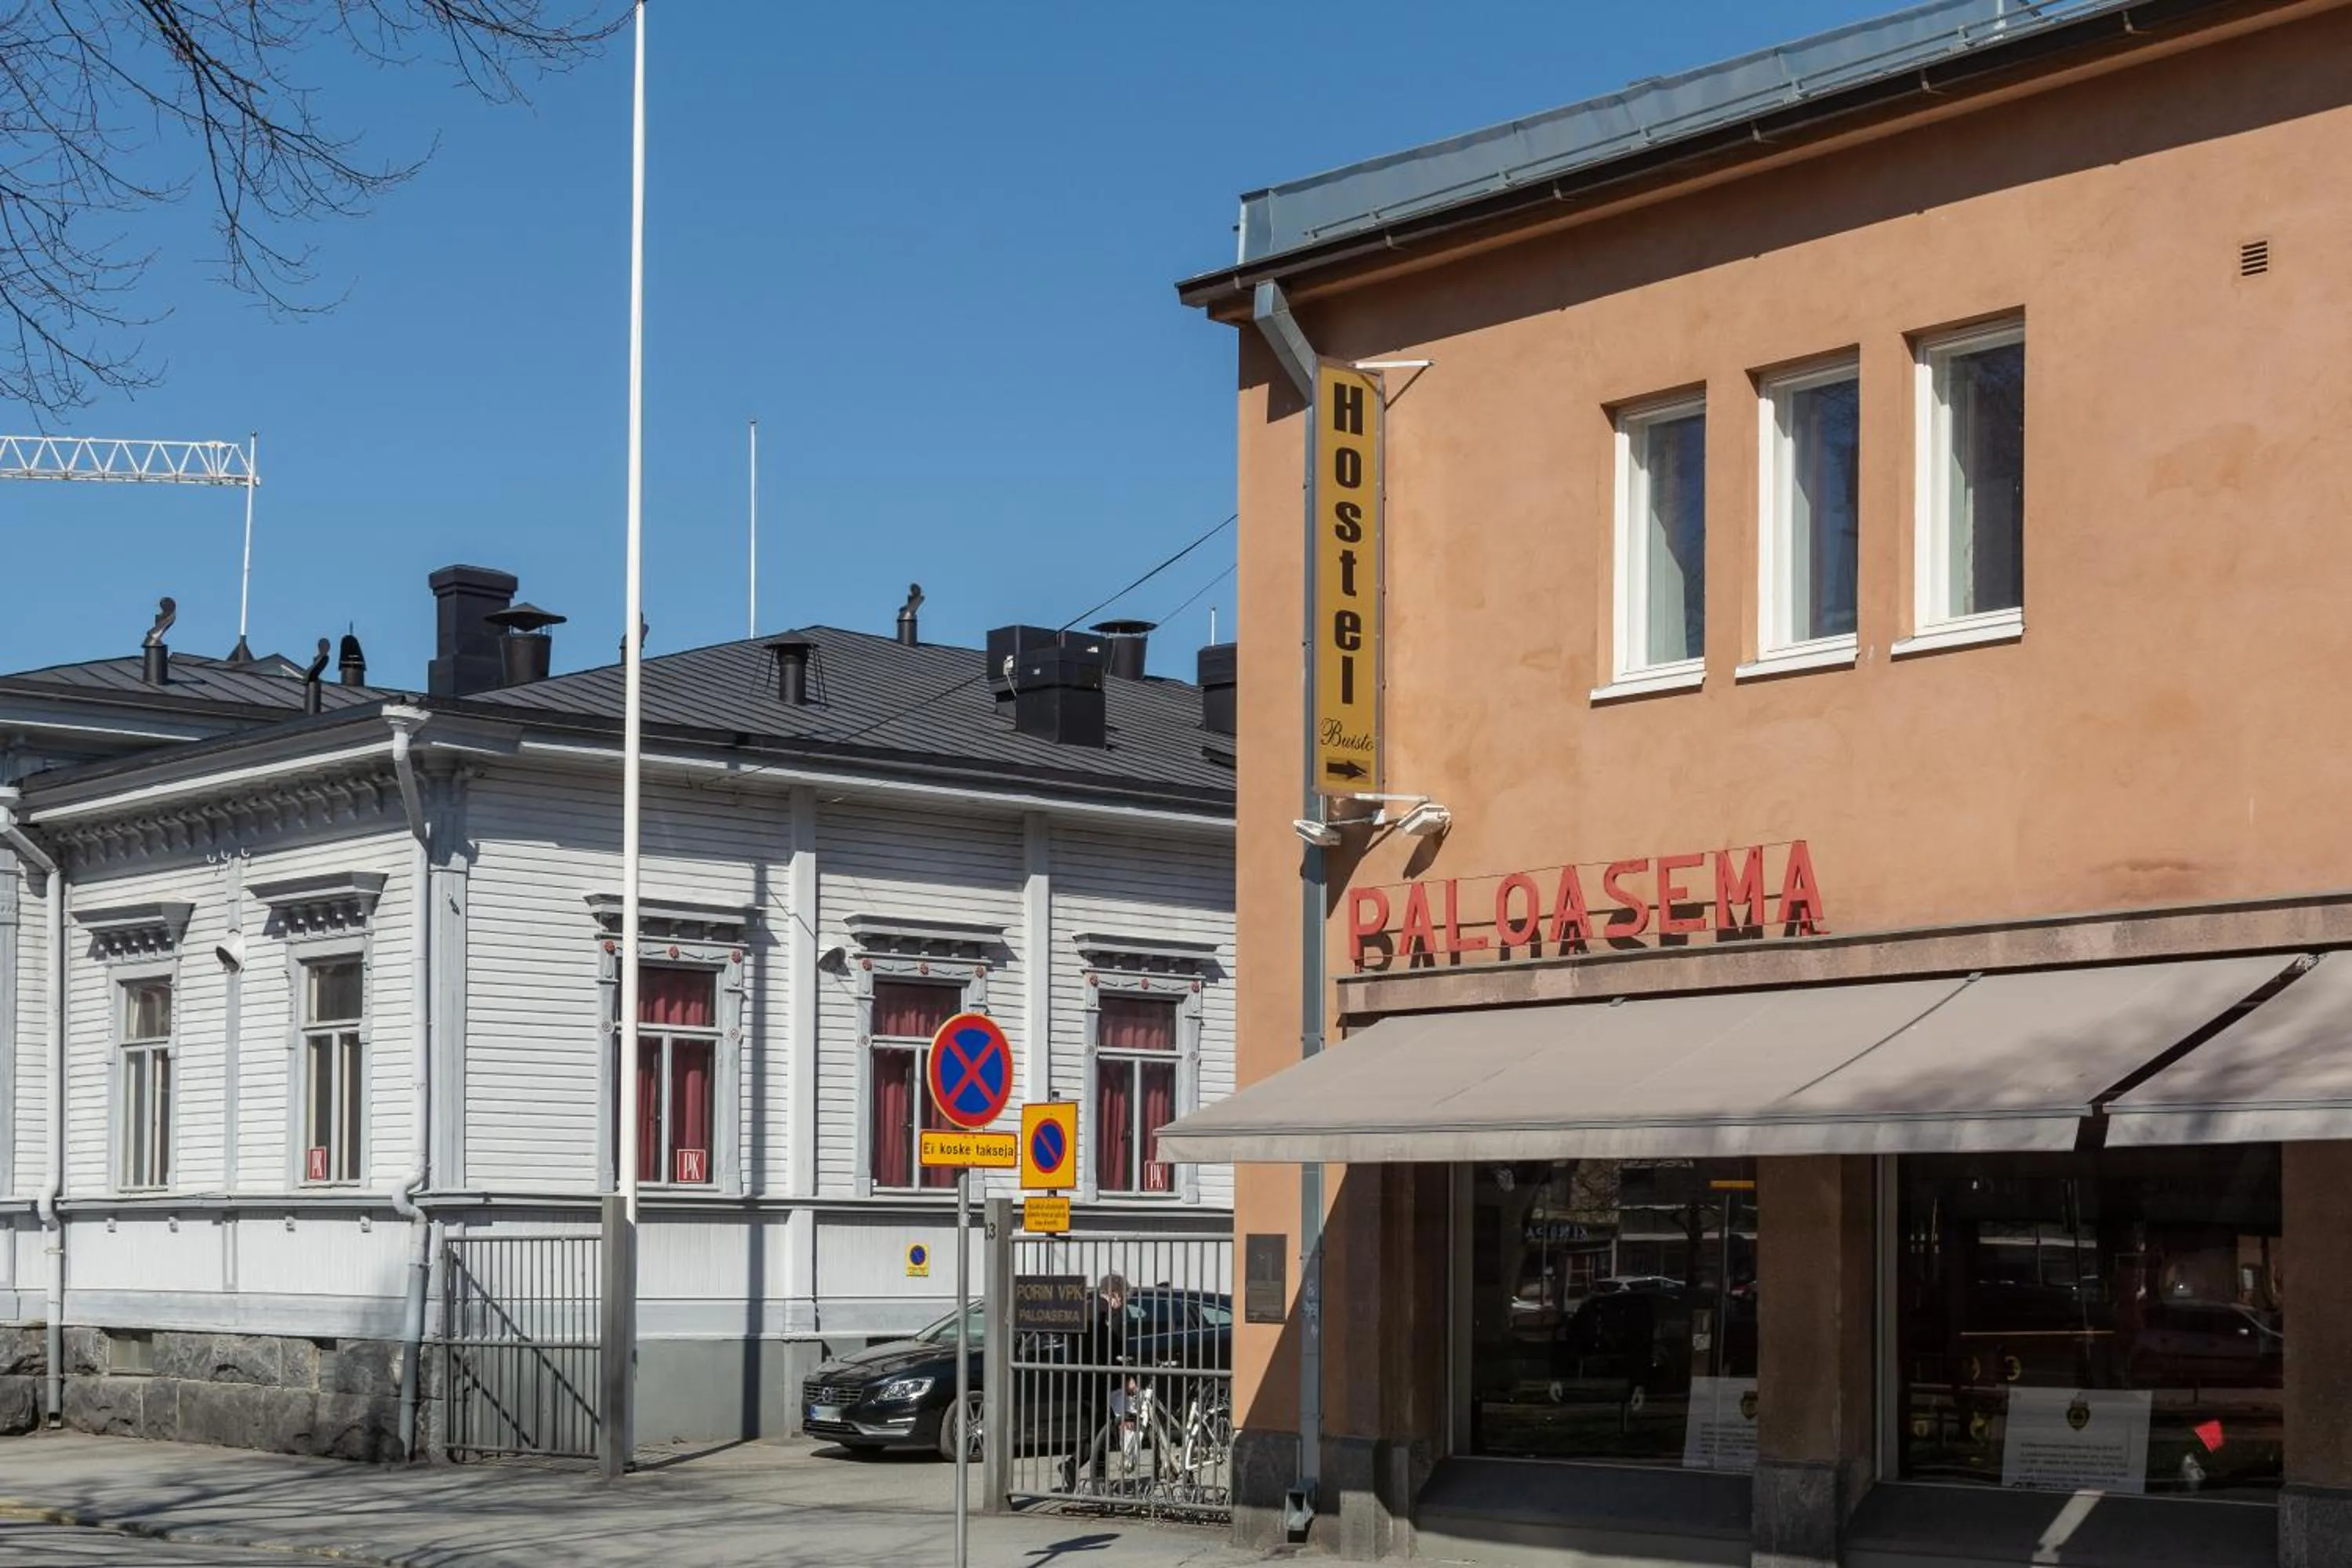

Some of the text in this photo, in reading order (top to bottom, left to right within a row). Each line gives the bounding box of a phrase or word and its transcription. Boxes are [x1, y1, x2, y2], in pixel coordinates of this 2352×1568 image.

[1334, 382, 1363, 705] Hostel
[1319, 717, 1374, 751] Buisto
[1348, 840, 1826, 961] PALOASEMA
[923, 1142, 1014, 1159] Ei koske takseja
[683, 1152, 700, 1180] PK
[1017, 1283, 1085, 1301] PORIN VPK
[1019, 1308, 1080, 1323] PALOASEMA
